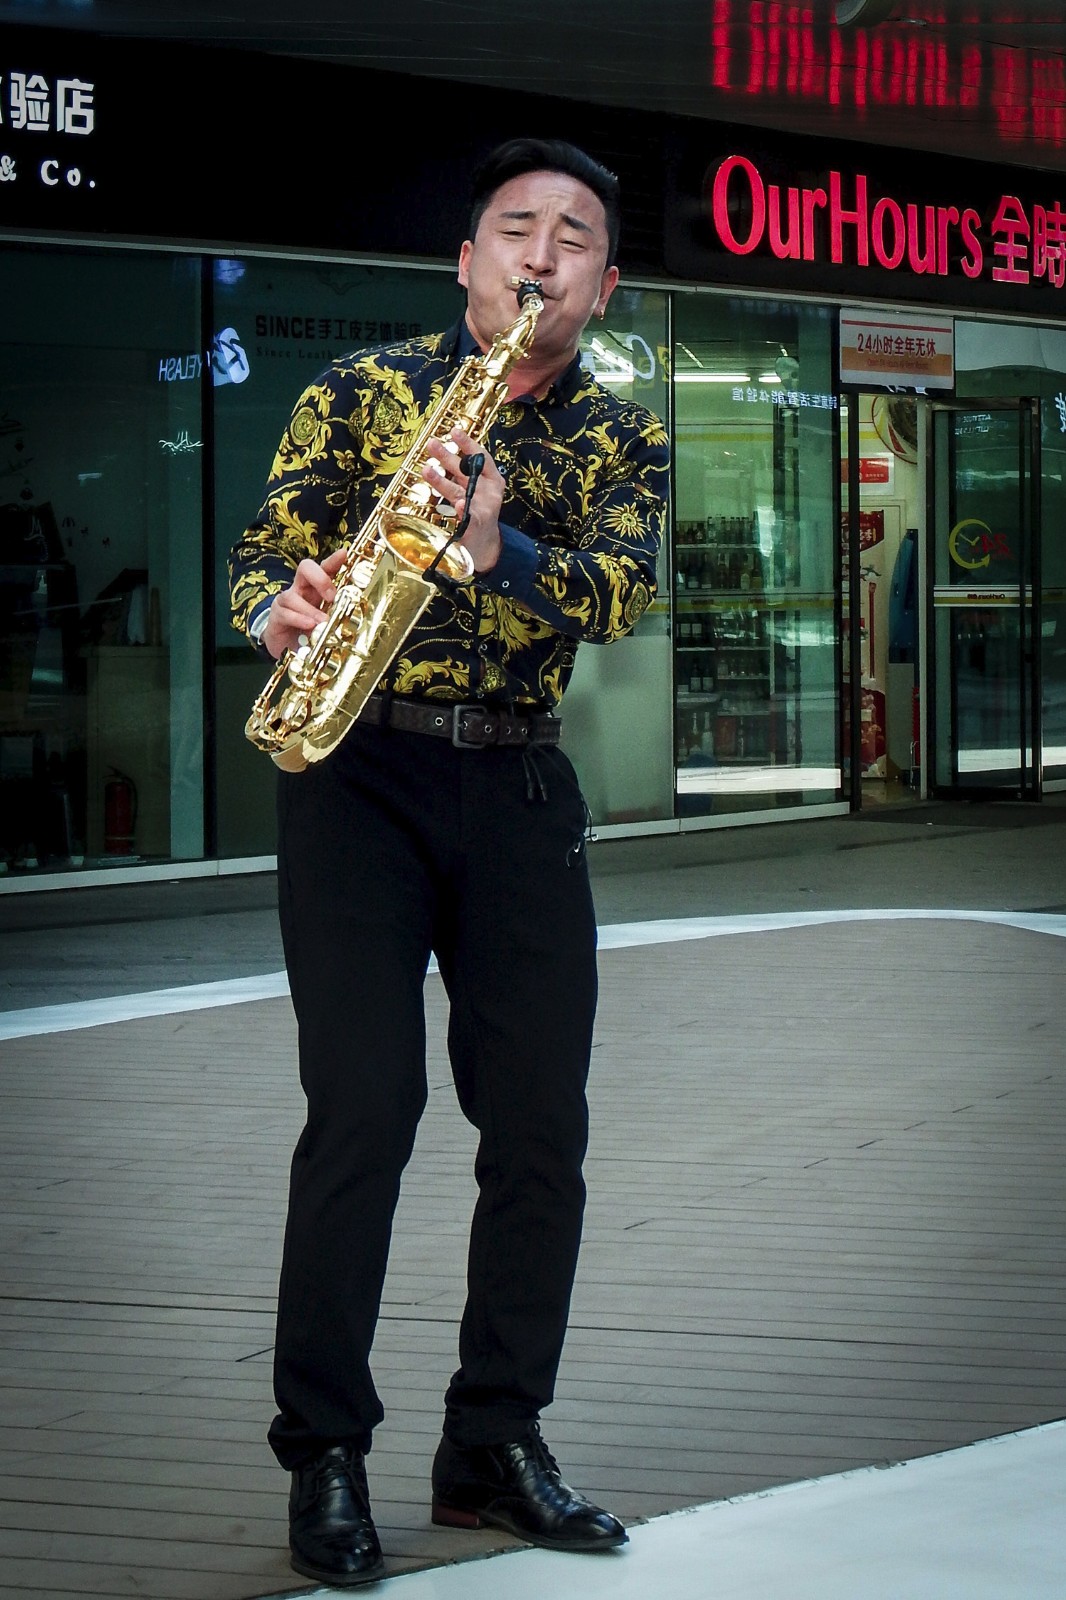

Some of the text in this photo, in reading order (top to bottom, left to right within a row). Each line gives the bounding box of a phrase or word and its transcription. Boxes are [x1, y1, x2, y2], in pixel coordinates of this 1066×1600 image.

[0, 72, 95, 136] 验店
[40, 159, 96, 188] Co.
[712, 154, 984, 279] OurHours
[857, 332, 937, 358] 24小时全年无休
